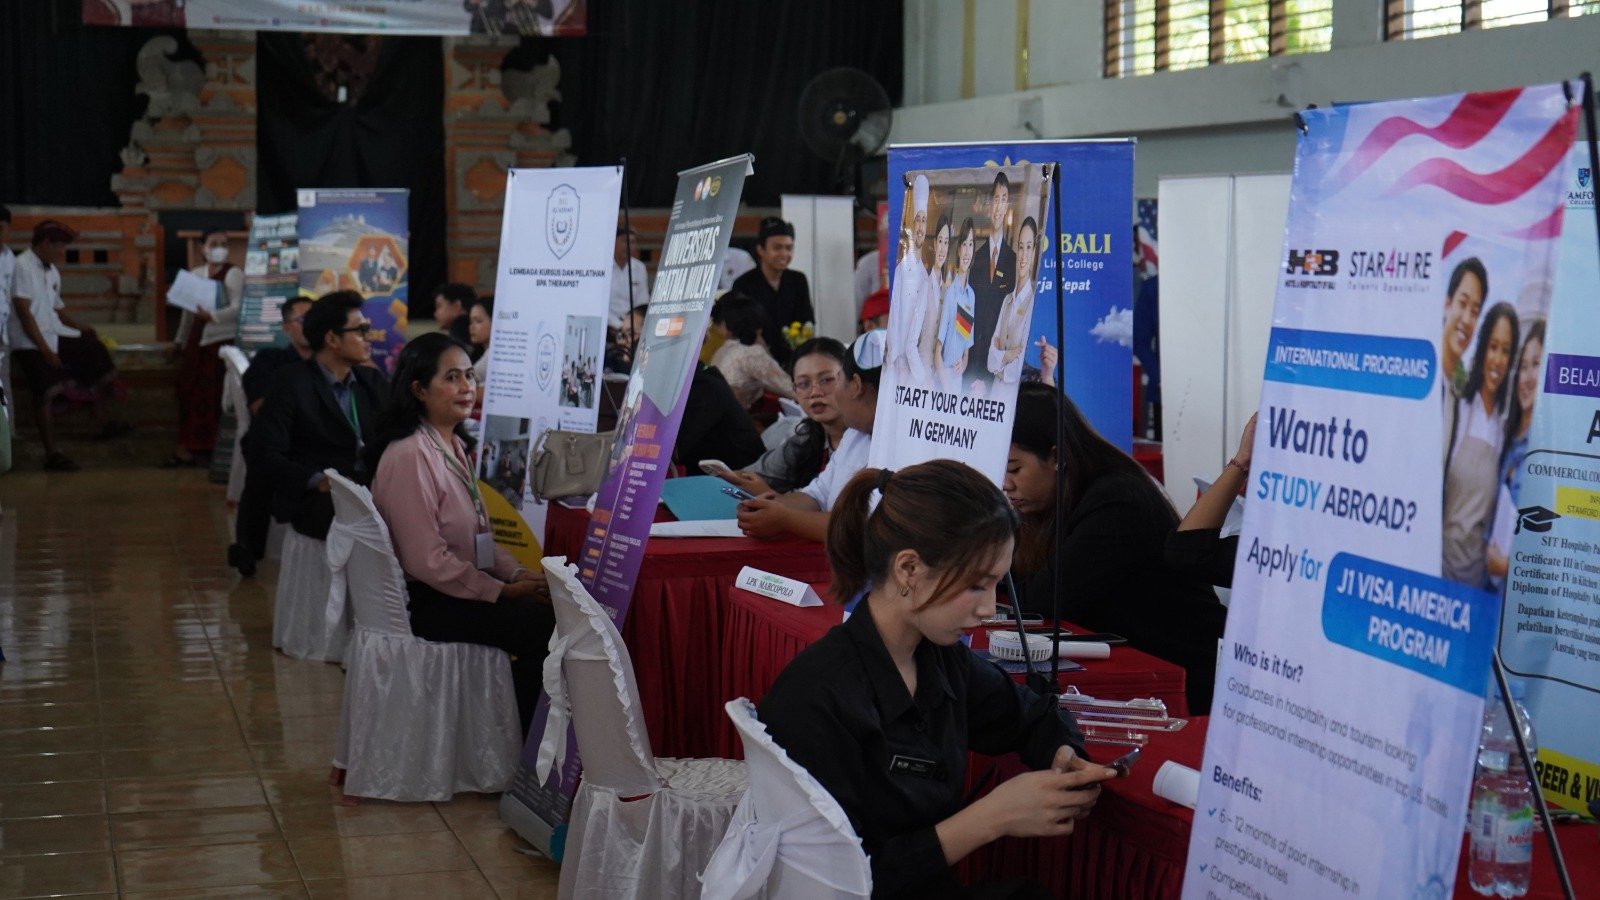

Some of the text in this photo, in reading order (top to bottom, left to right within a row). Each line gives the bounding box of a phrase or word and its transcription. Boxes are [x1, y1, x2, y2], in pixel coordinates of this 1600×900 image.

[1061, 233, 1111, 254] BALI
[1067, 258, 1104, 271] College
[1350, 248, 1432, 279] STAR4HRE
[1061, 277, 1091, 294] epat
[1275, 346, 1429, 379] INTERNATIONAL PROGRAMS
[1559, 366, 1600, 387] BELAJ
[895, 385, 1005, 423] START YOUR CAREER
[909, 418, 977, 450] IN GERMANY
[1270, 406, 1368, 464] Want to
[1527, 463, 1588, 481] COMMERCIAL
[1257, 470, 1417, 533] STUDY ABROAD?
[1541, 536, 1557, 548] SIT
[1247, 537, 1323, 582] Apply for
[1514, 566, 1559, 582] Certificate
[1562, 572, 1572, 582] IV
[1515, 551, 1561, 567] Certificate
[1563, 557, 1573, 569] III
[746, 576, 794, 597] LPK MARCOPOLO
[1337, 568, 1471, 633] J1 VISA AMERICA
[1512, 580, 1548, 597] Diploma
[1551, 587, 1560, 597] of
[1518, 603, 1555, 619] Dapatkan
[1368, 616, 1450, 668] PROGRAM
[1517, 621, 1553, 634] pelatihan
[1233, 643, 1303, 683] Who is it for?
[1227, 677, 1418, 772] Graduates in hospitality and tourism looking
[1223, 702, 1236, 719] for
[1236, 708, 1286, 741] professional
[1287, 730, 1326, 761] internship
[1328, 750, 1384, 787] opportunities
[1213, 765, 1262, 802] Benefits:
[1535, 760, 1568, 795] REER
[1570, 772, 1581, 800] &
[1214, 836, 1289, 885] prestigious hotels
[1219, 808, 1227, 824] 6
[1235, 815, 1245, 832] 12
[1245, 823, 1277, 849] months
[1278, 839, 1288, 853] of
[1288, 846, 1307, 866] paid
[1308, 858, 1351, 891] internship
